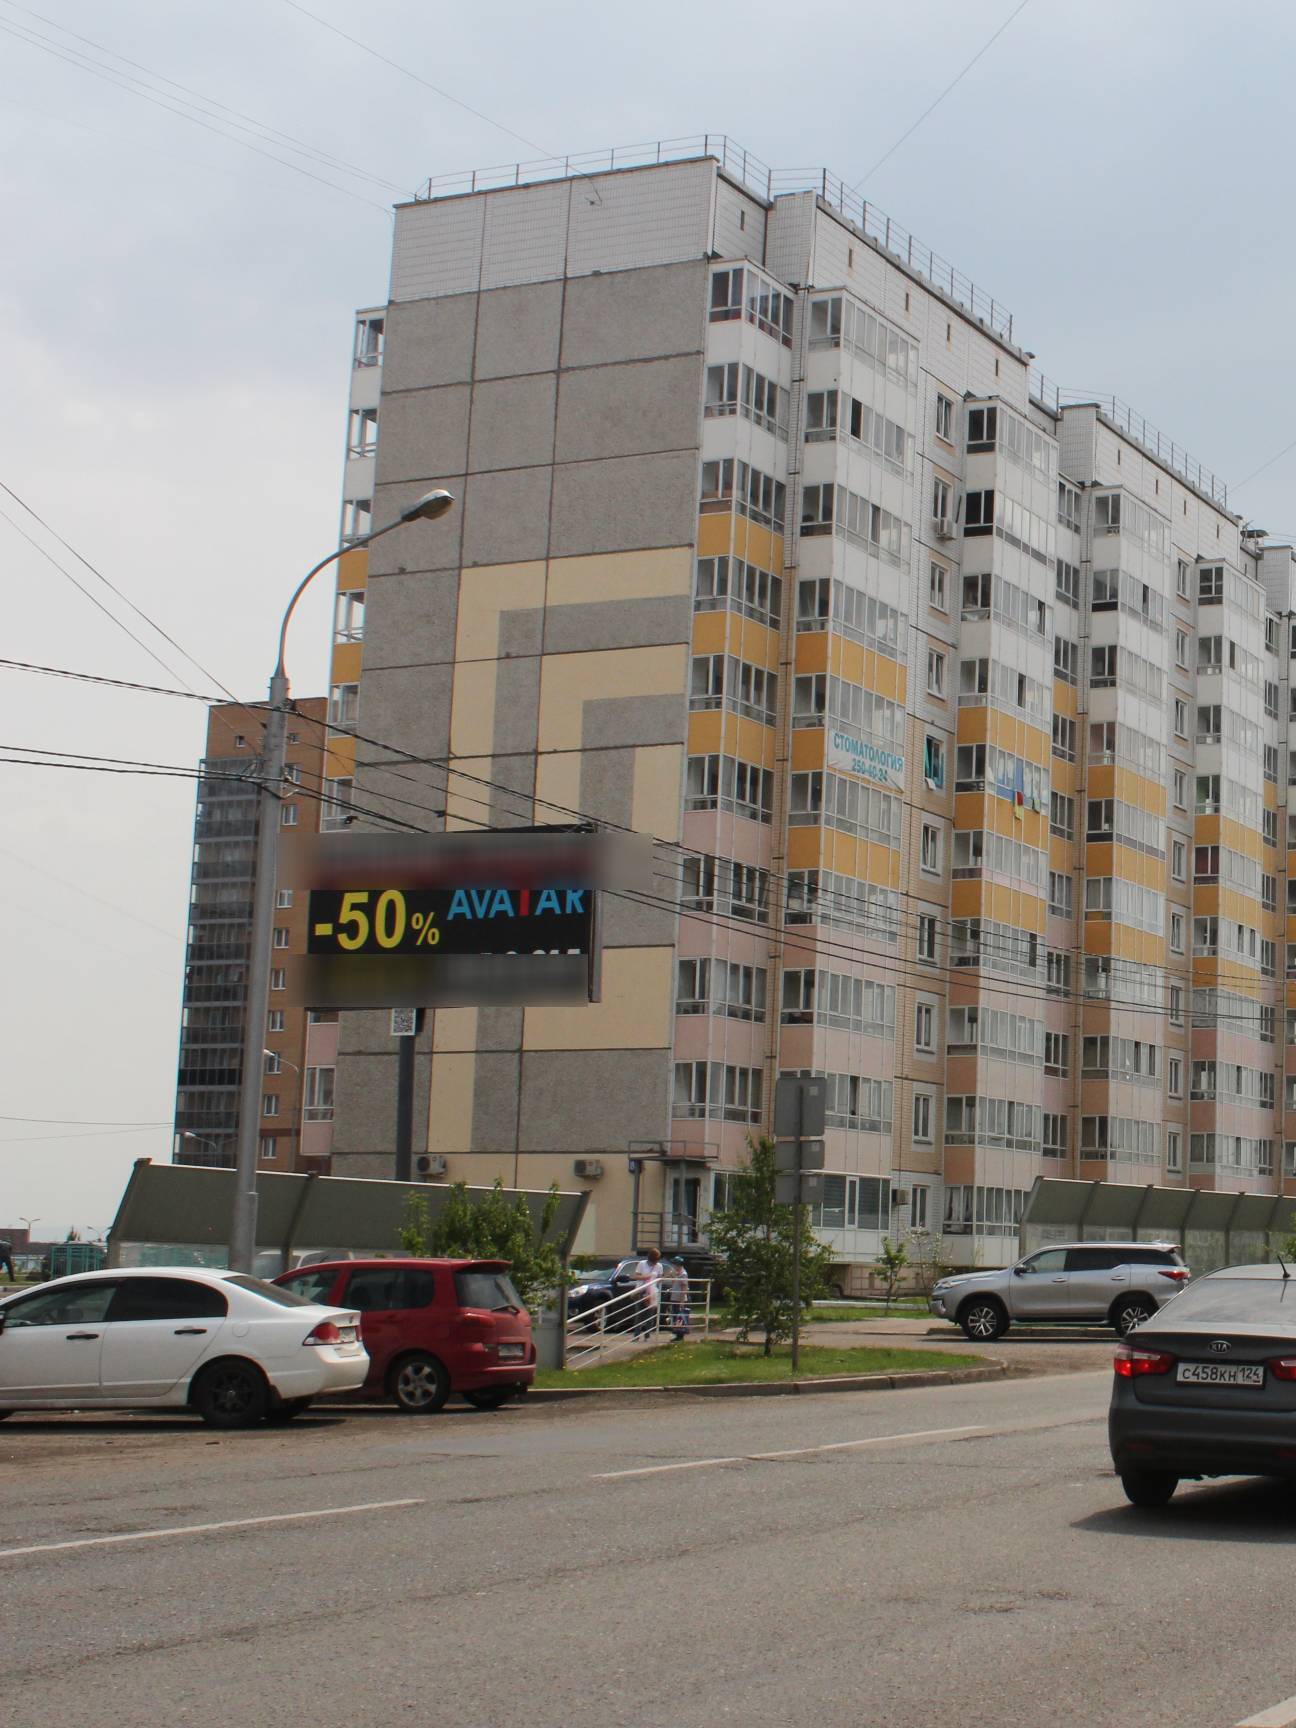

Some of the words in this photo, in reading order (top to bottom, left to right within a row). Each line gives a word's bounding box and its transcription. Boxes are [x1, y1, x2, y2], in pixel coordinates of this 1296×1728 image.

[833, 732, 903, 772] СТОМАТОЛОГИЯ
[1211, 1343, 1228, 1351] KIA
[1240, 1367, 1260, 1379] 124
